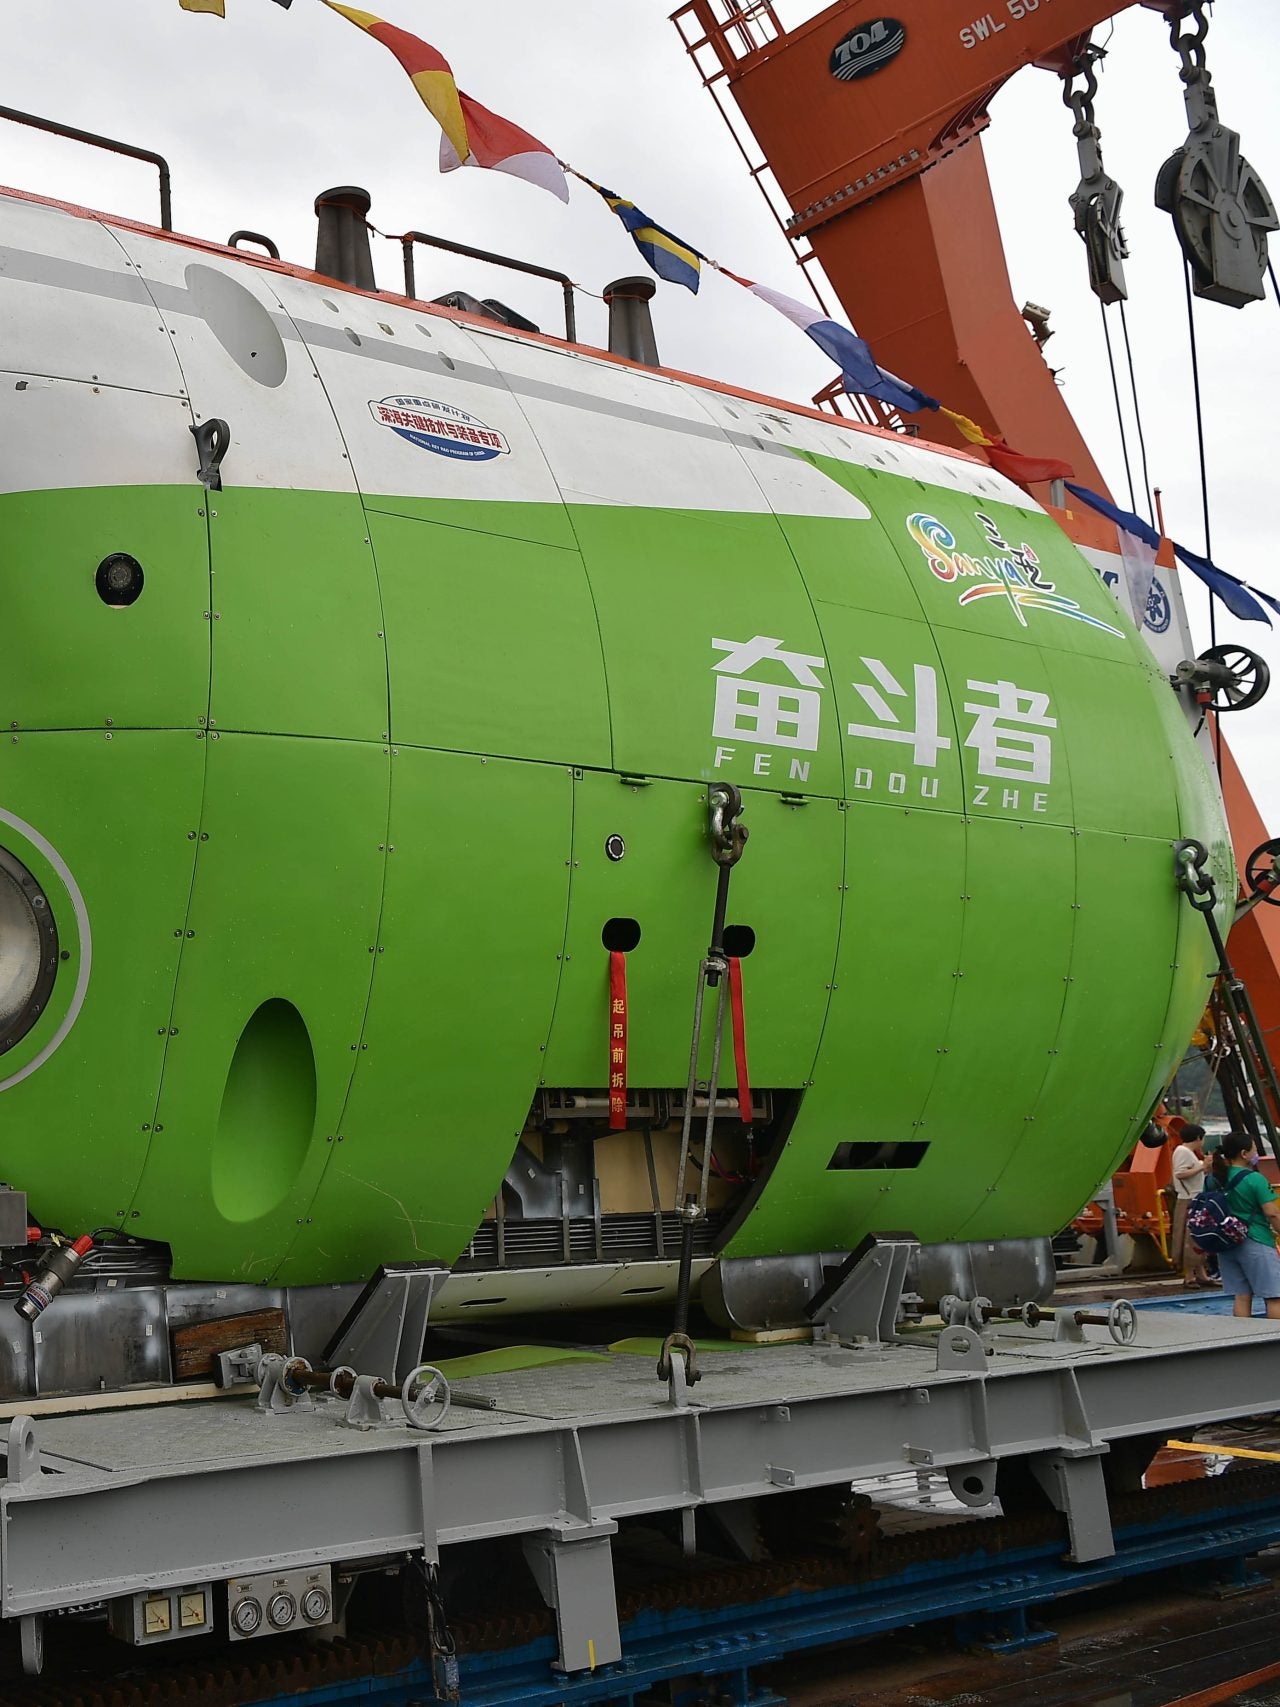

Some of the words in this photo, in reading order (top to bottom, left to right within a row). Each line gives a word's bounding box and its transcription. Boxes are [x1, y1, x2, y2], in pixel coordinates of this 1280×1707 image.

[835, 21, 889, 64] 704
[959, 14, 1007, 49] SWL
[377, 405, 503, 449] 深海关键技术与装备专项
[906, 512, 1027, 590] Sanya
[711, 635, 1058, 784] 奋斗者
[713, 745, 811, 782] FEN
[854, 767, 940, 798] DOU
[972, 785, 1048, 812] ZHE
[611, 998, 625, 1113] 起吊前拆除
